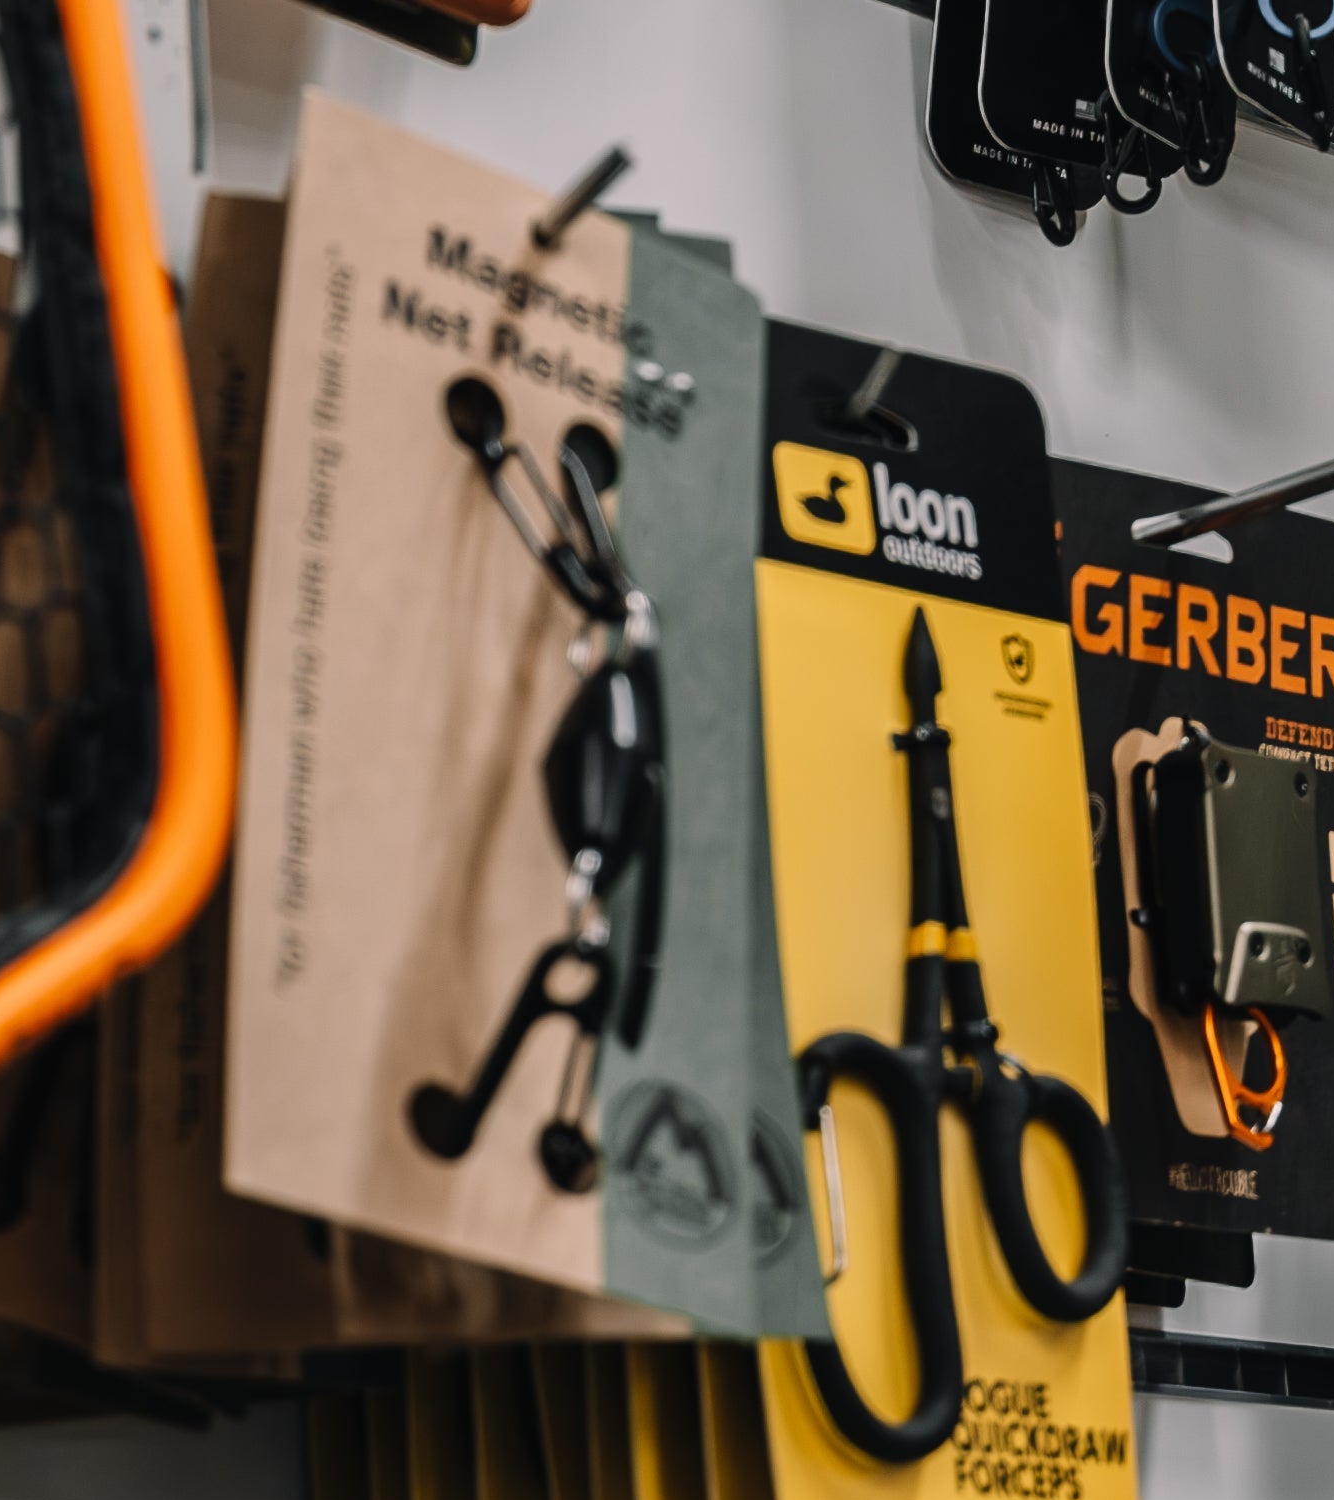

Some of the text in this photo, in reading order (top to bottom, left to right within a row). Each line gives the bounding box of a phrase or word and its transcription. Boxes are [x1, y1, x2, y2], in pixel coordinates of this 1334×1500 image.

[973, 143, 1003, 161] MADE
[1032, 118, 1066, 136] MADE
[1070, 127, 1084, 140] IN
[382, 276, 472, 351] Net
[872, 460, 979, 549] loon
[882, 533, 983, 581] outdoors
[964, 1374, 1050, 1419] OGUE
